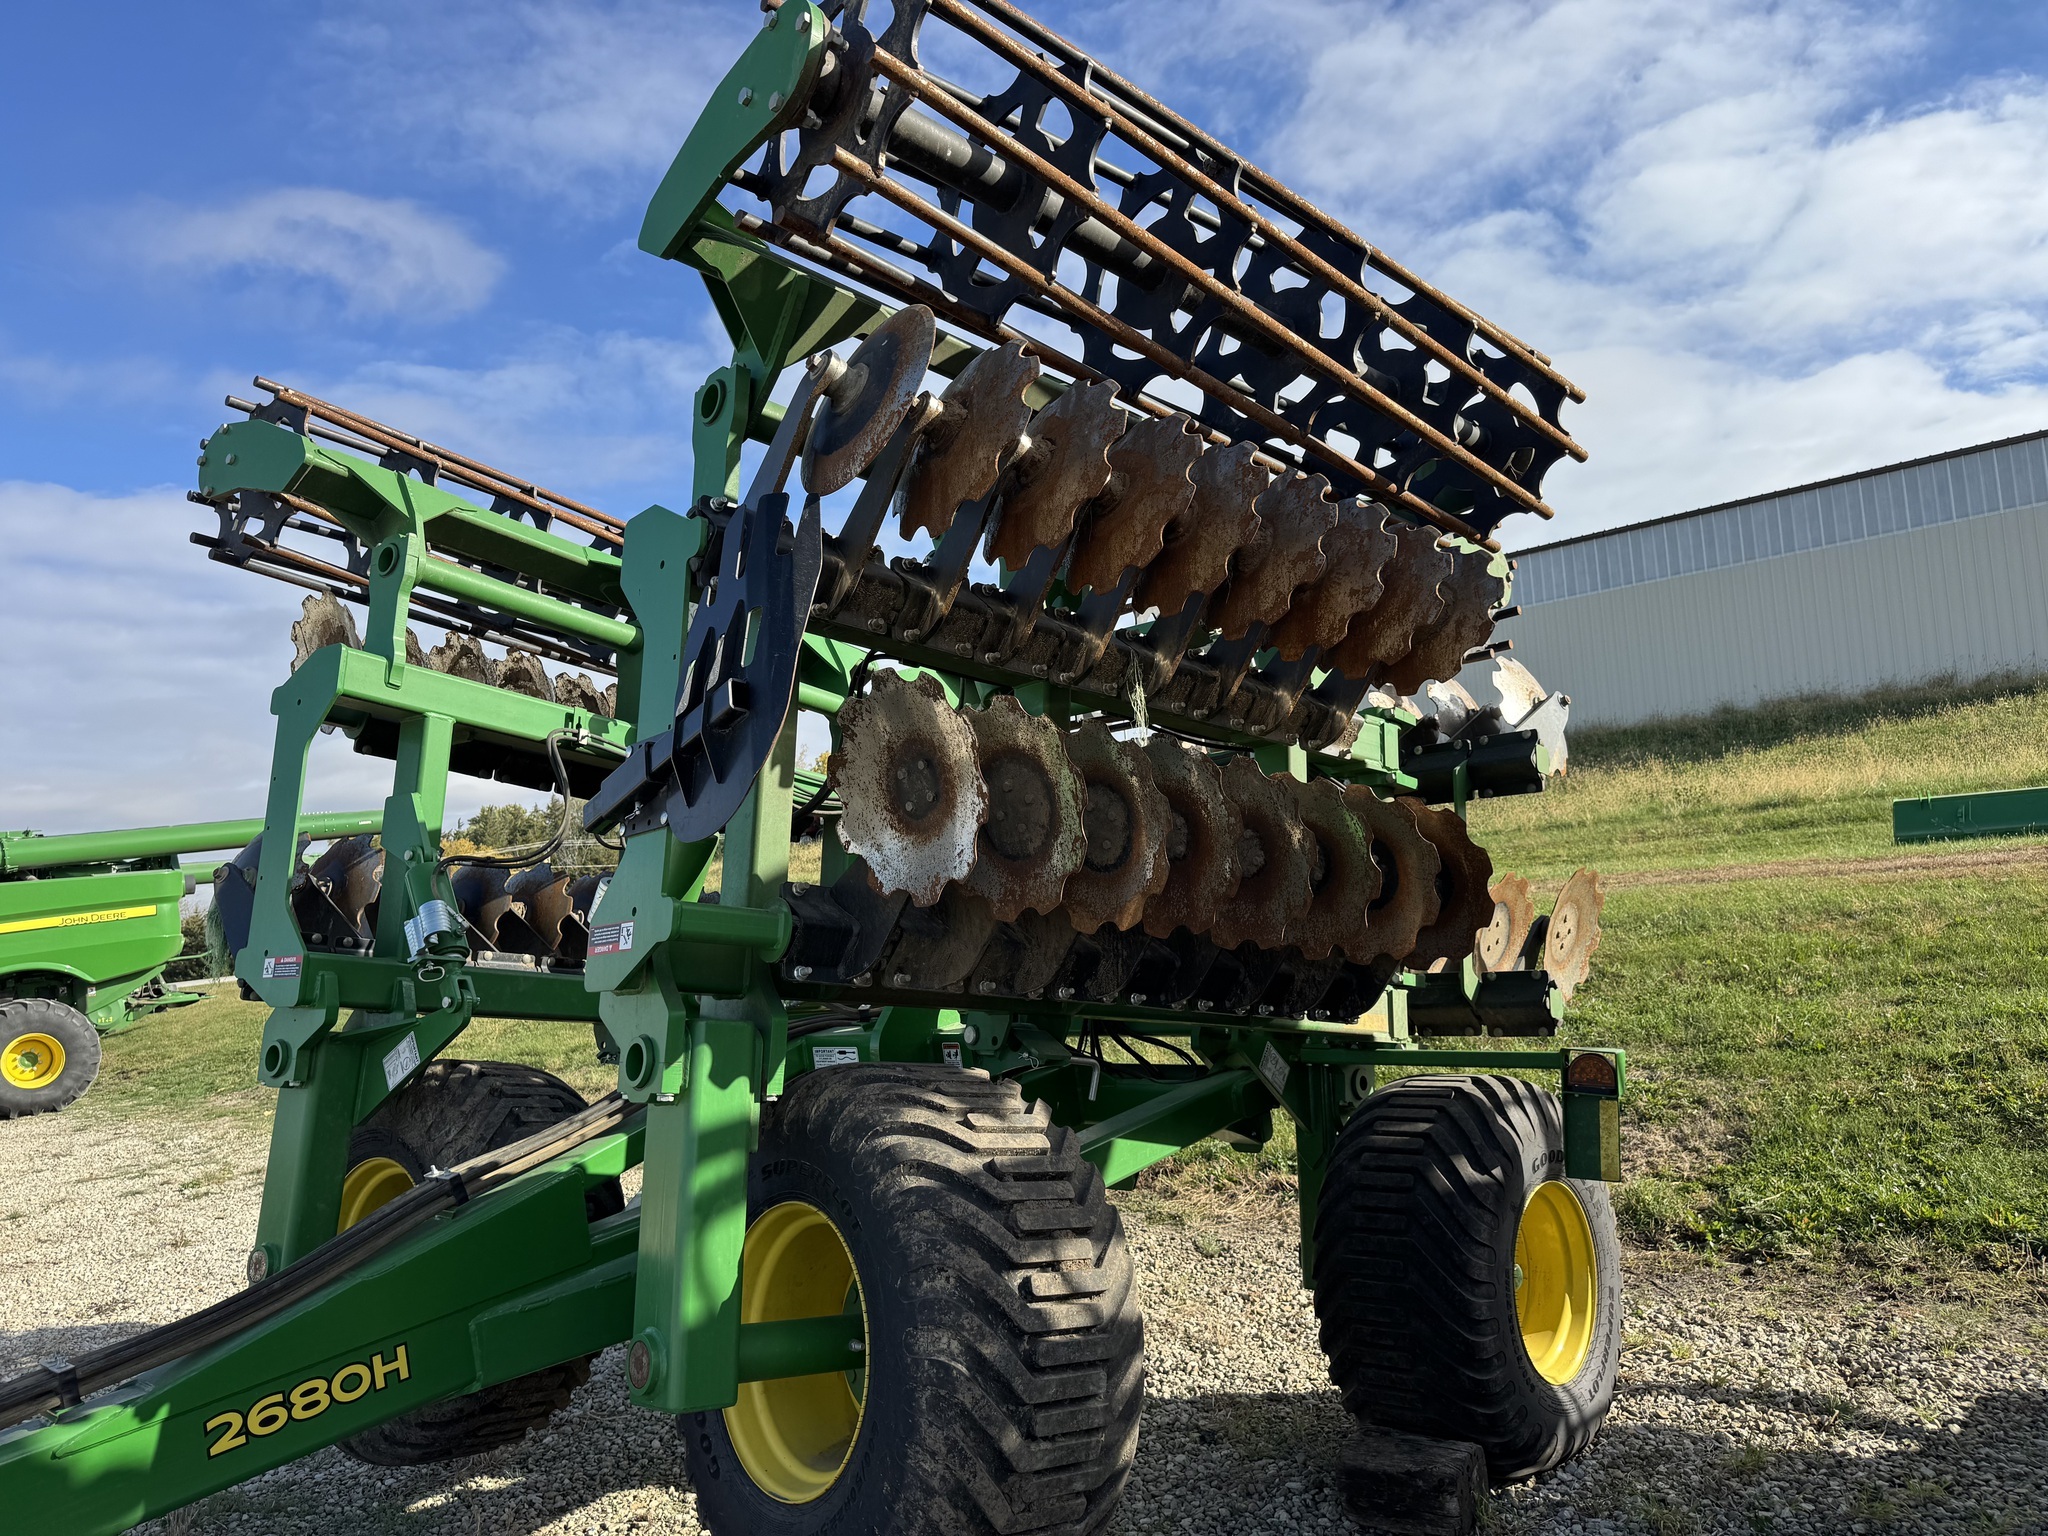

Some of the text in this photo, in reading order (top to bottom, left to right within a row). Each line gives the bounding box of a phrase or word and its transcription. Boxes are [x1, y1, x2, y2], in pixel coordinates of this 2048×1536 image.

[59, 911, 127, 926] JOHN DEERE
[204, 1342, 411, 1459] 2680H
[1588, 1285, 1615, 1402] SUPERFLOT
